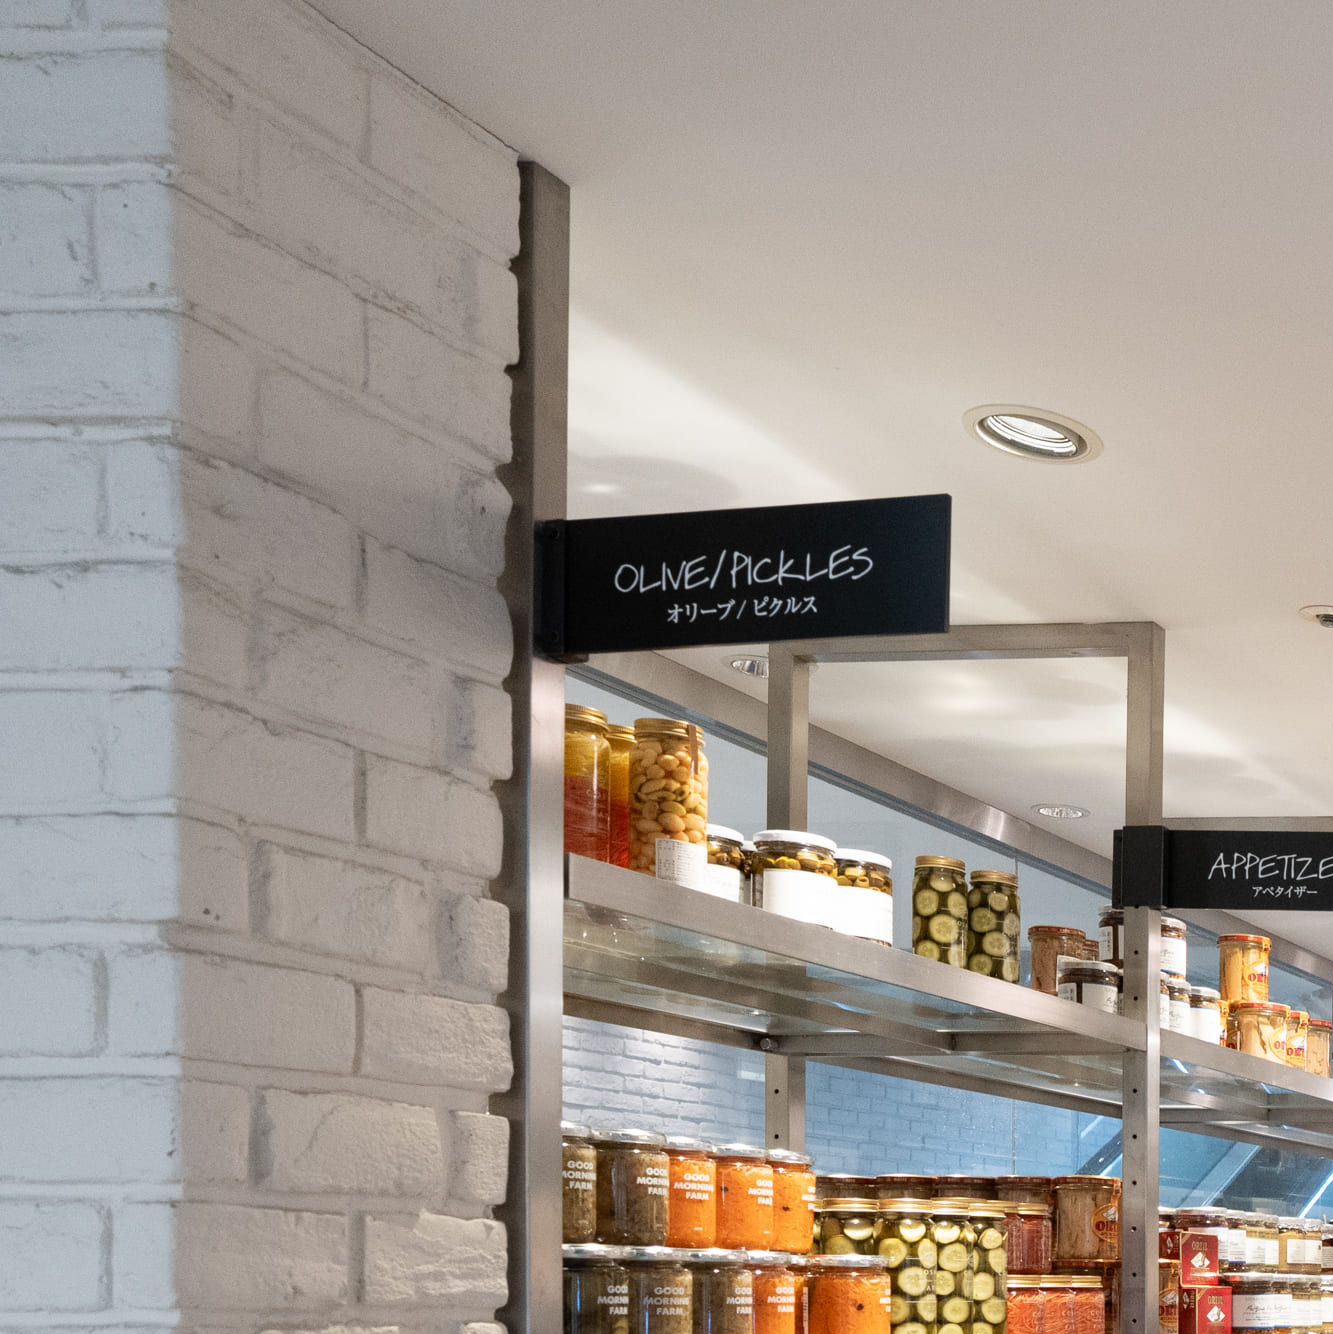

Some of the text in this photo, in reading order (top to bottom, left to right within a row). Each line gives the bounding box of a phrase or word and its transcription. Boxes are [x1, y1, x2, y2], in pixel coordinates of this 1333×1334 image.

[1252, 885, 1319, 898] アペタイザー
[683, 1173, 710, 1182] GOOD
[685, 1191, 710, 1201] FARM
[654, 1287, 685, 1296] GOOD
[656, 1307, 685, 1316] FARM
